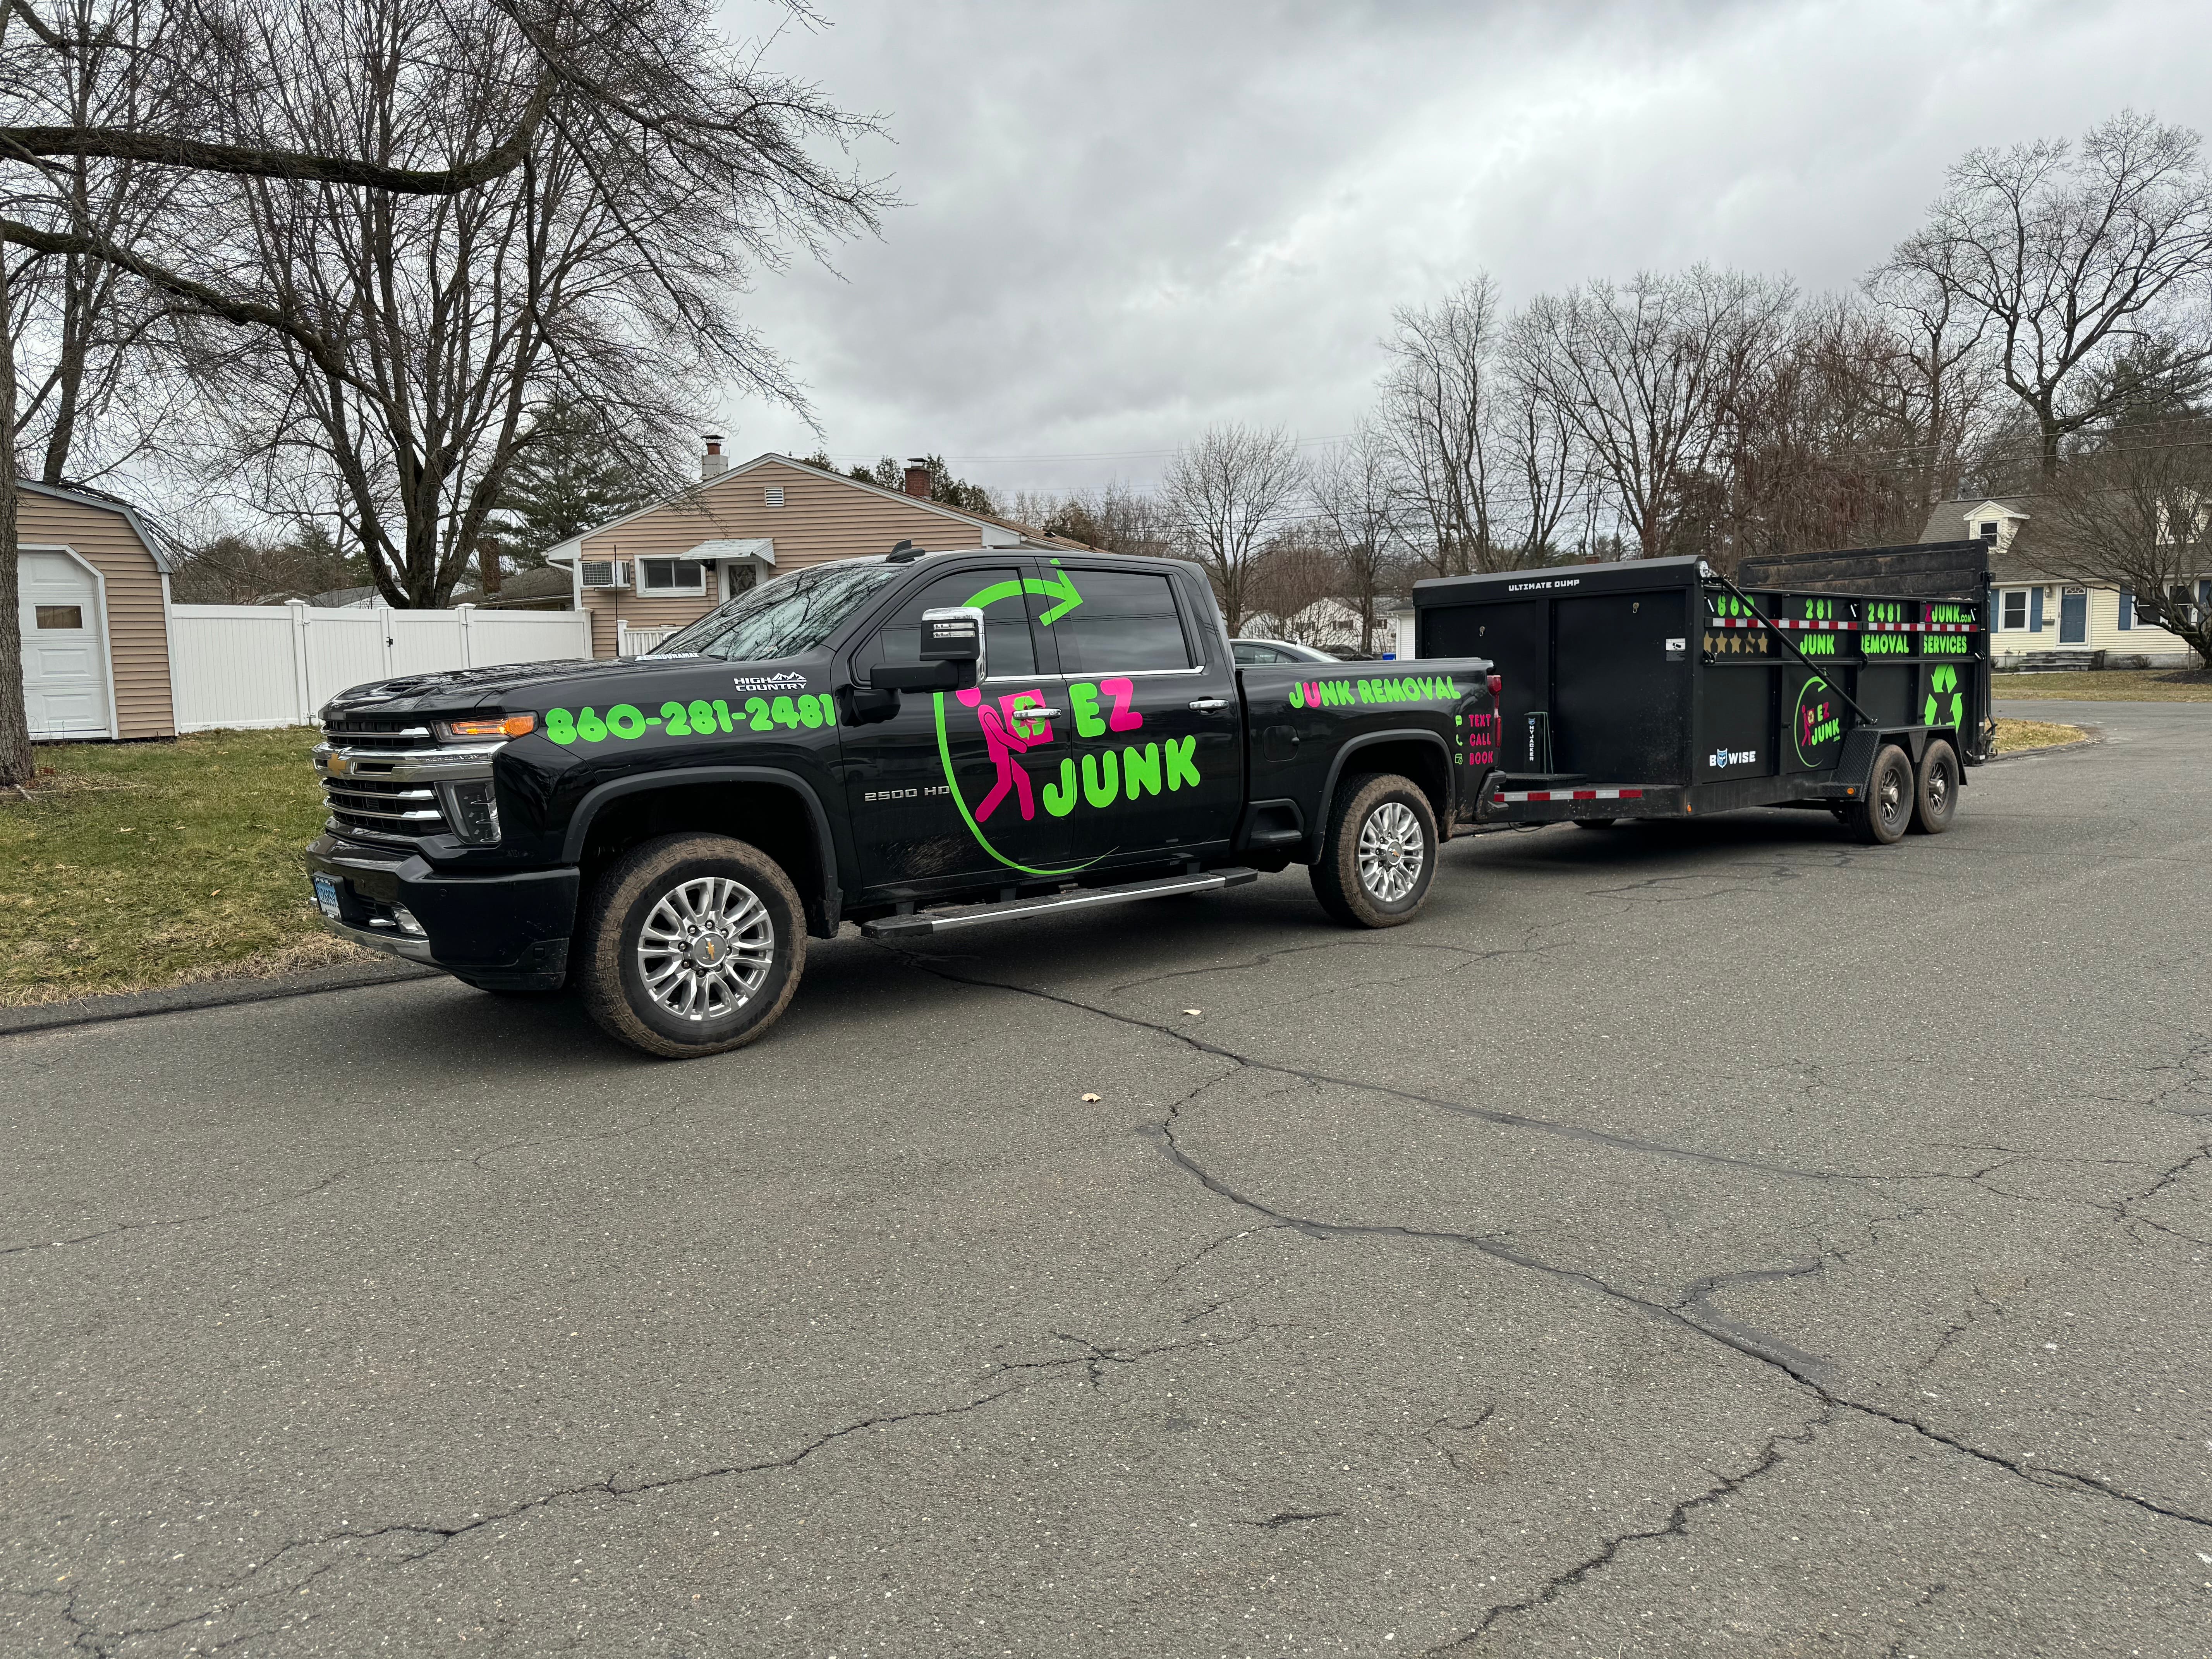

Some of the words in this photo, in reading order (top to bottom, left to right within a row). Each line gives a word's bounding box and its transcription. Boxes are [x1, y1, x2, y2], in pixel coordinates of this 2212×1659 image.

[1509, 582, 1552, 591] ULTIMATE
[1554, 579, 1580, 587] DUMP
[1806, 599, 1832, 620] 281
[1868, 602, 1901, 622] 2481
[1800, 634, 1835, 655] JUNK
[1923, 635, 1967, 654] SERVICES
[736, 683, 806, 691] COUNTRY
[1289, 681, 1355, 709] JUNK
[1357, 676, 1462, 704] REMOVAL
[1069, 677, 1143, 737] EZ
[1817, 702, 1830, 722] EZ
[545, 694, 836, 745] 860-281-2481
[1469, 714, 1491, 727] TEXT
[1469, 733, 1491, 746] CALL
[1812, 718, 1840, 745] JUNK
[1469, 751, 1493, 765] BOOK
[1042, 735, 1200, 817] JUNK
[865, 789, 917, 802] 2500
[924, 786, 950, 796] HD
